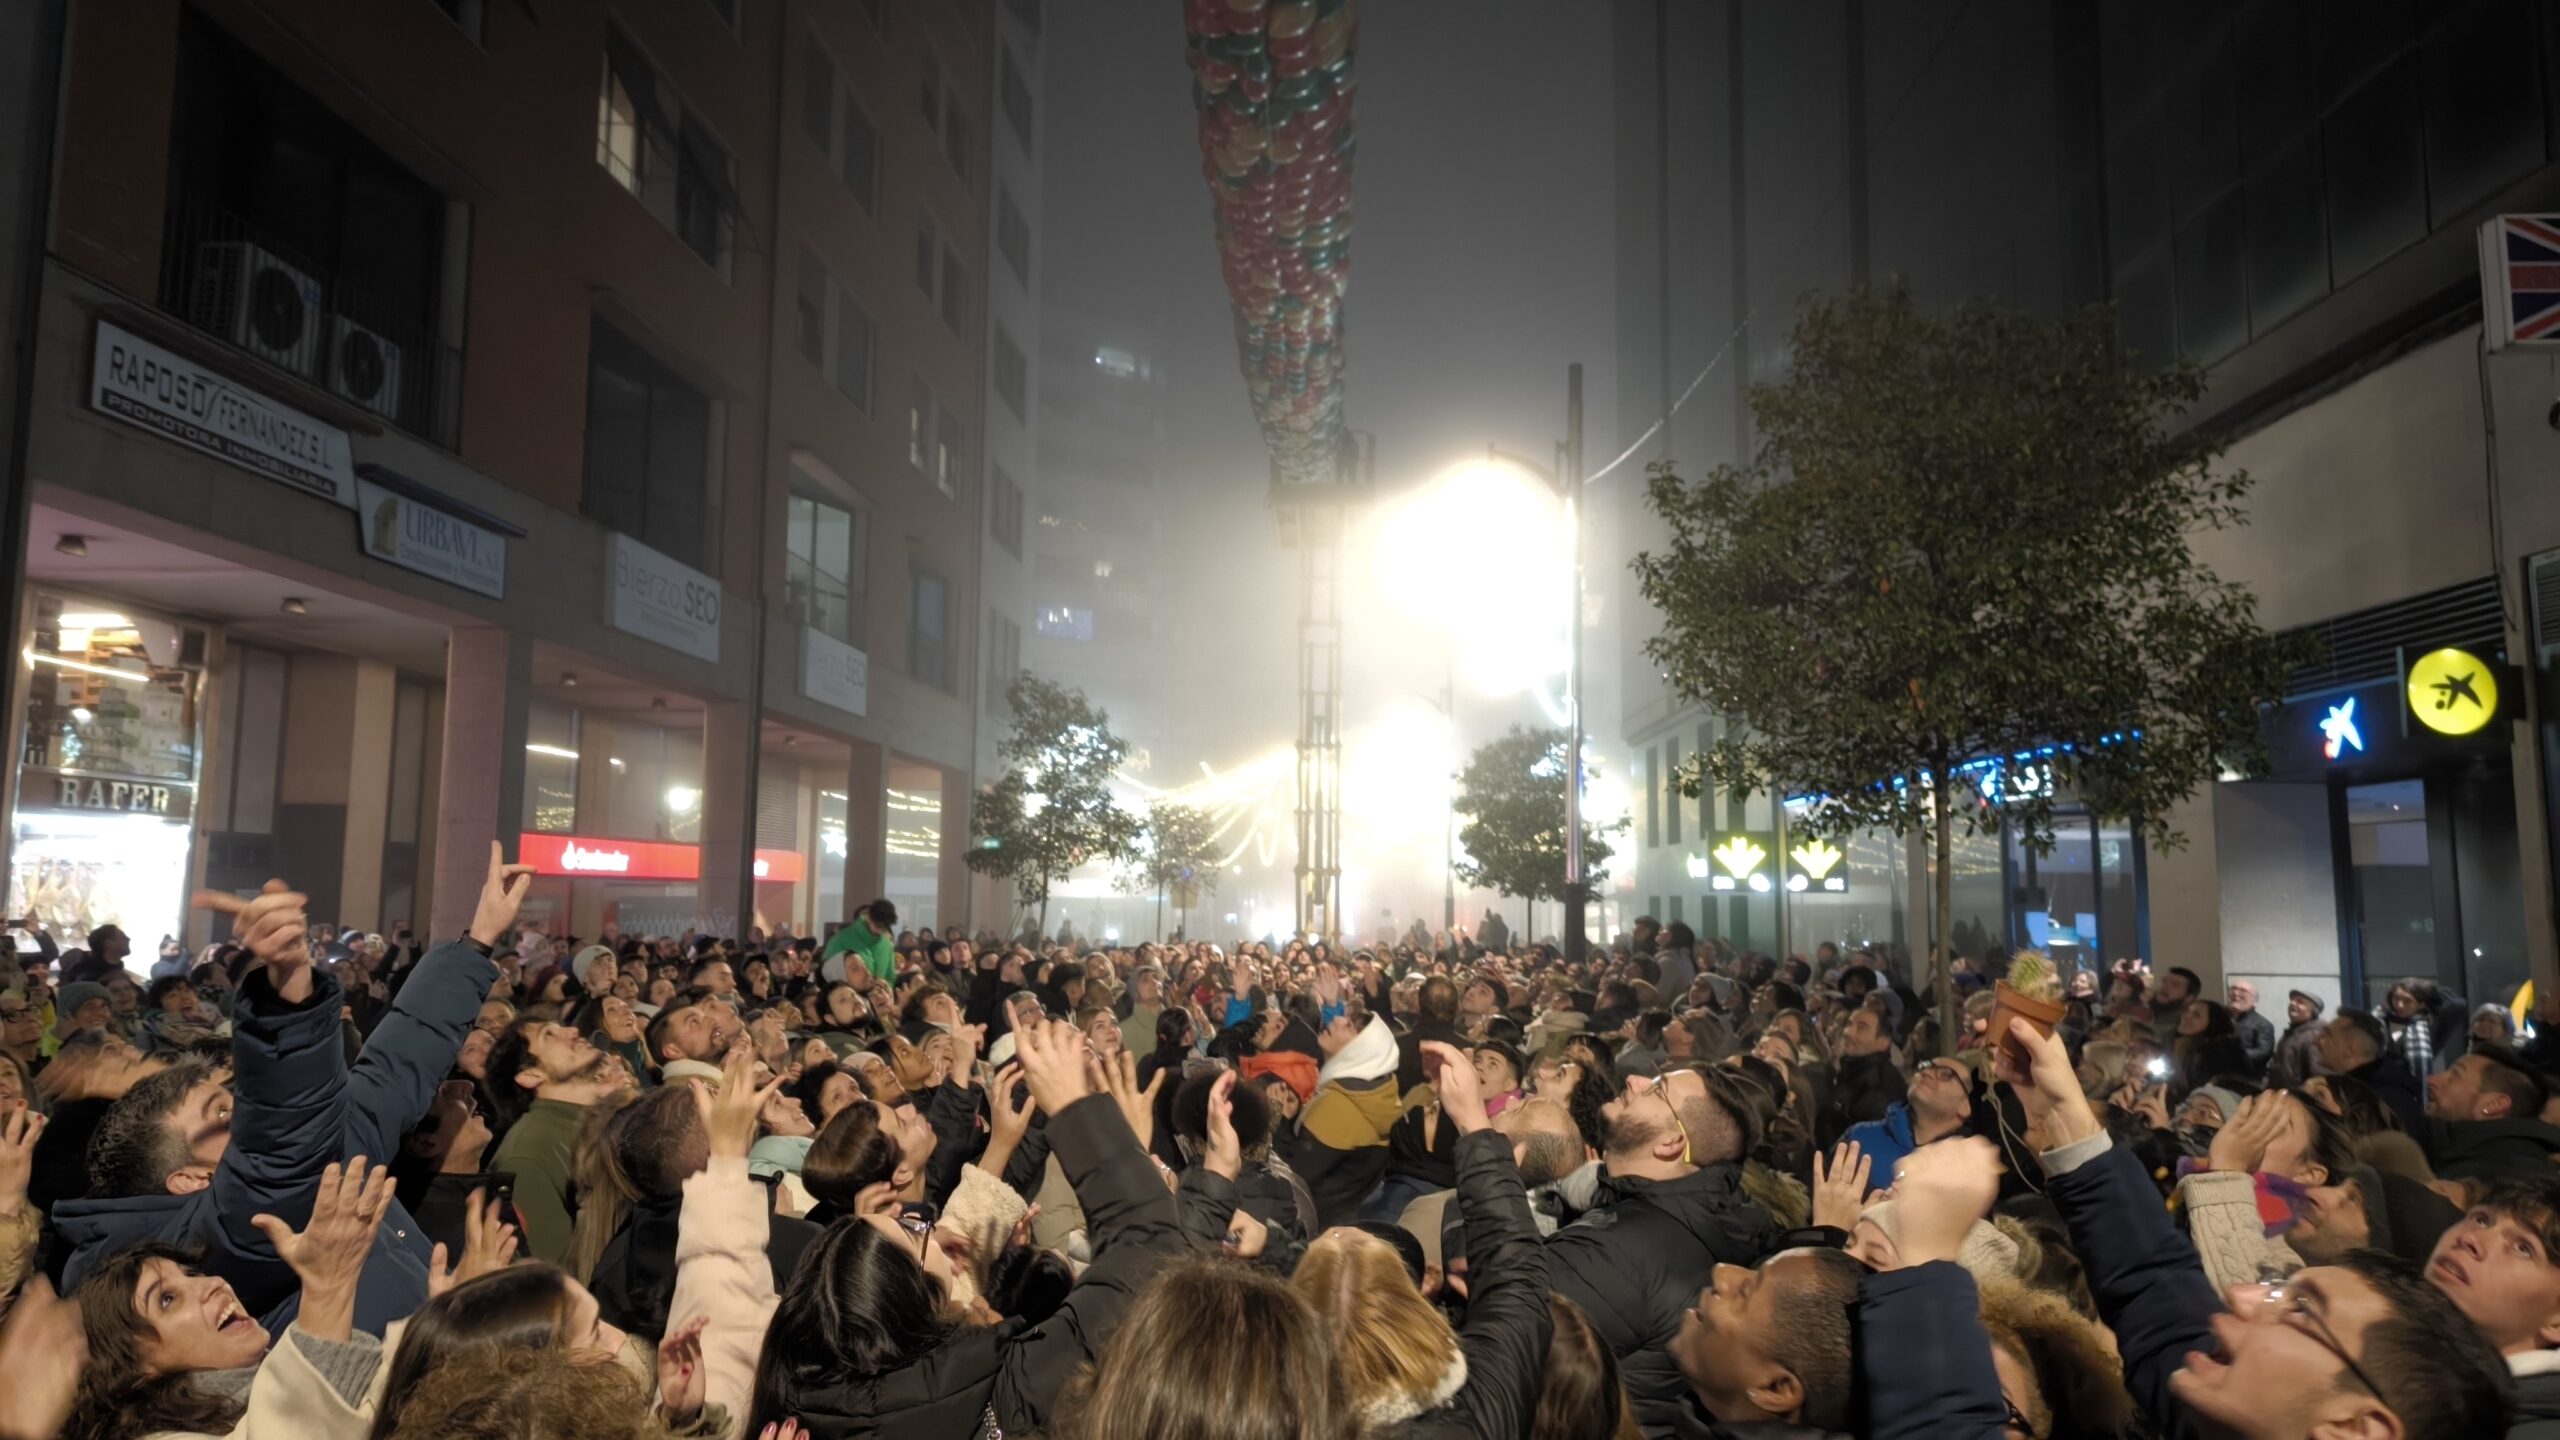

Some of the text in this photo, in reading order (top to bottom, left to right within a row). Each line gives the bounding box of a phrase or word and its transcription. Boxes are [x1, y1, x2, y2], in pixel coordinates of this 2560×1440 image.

[109, 345, 206, 418] RAPOSO
[107, 393, 333, 494] PROMOTORA INMOBILIARIA
[60, 778, 169, 813] RAFER
